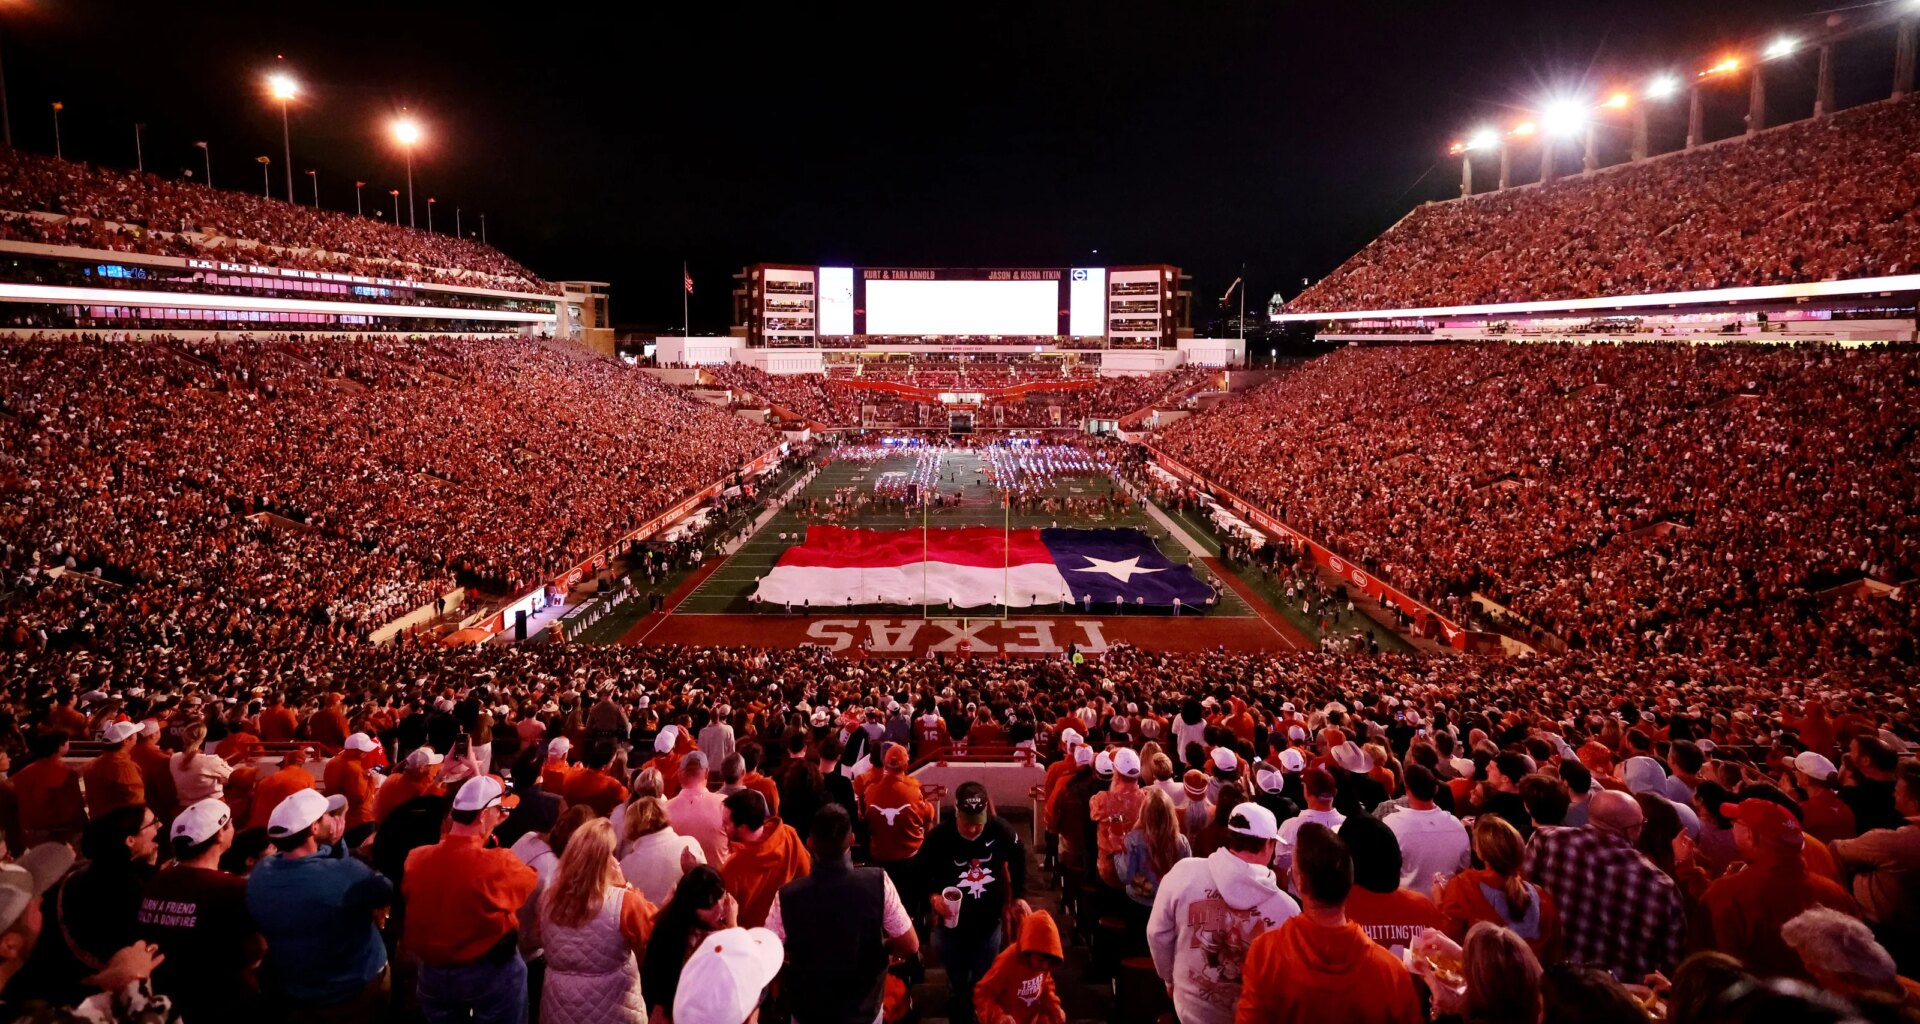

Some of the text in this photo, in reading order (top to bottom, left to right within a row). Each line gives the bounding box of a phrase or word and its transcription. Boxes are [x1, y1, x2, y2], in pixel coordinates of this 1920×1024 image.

[863, 270, 935, 280] KURT & TARA ARNOLD
[988, 270, 1061, 280] JASON & KISHA ITKIN
[554, 597, 562, 606] H
[801, 619, 1107, 653] TEXAS
[923, 730, 938, 742] 16
[166, 902, 197, 915] FRIEND
[160, 914, 198, 928] BONFIRE
